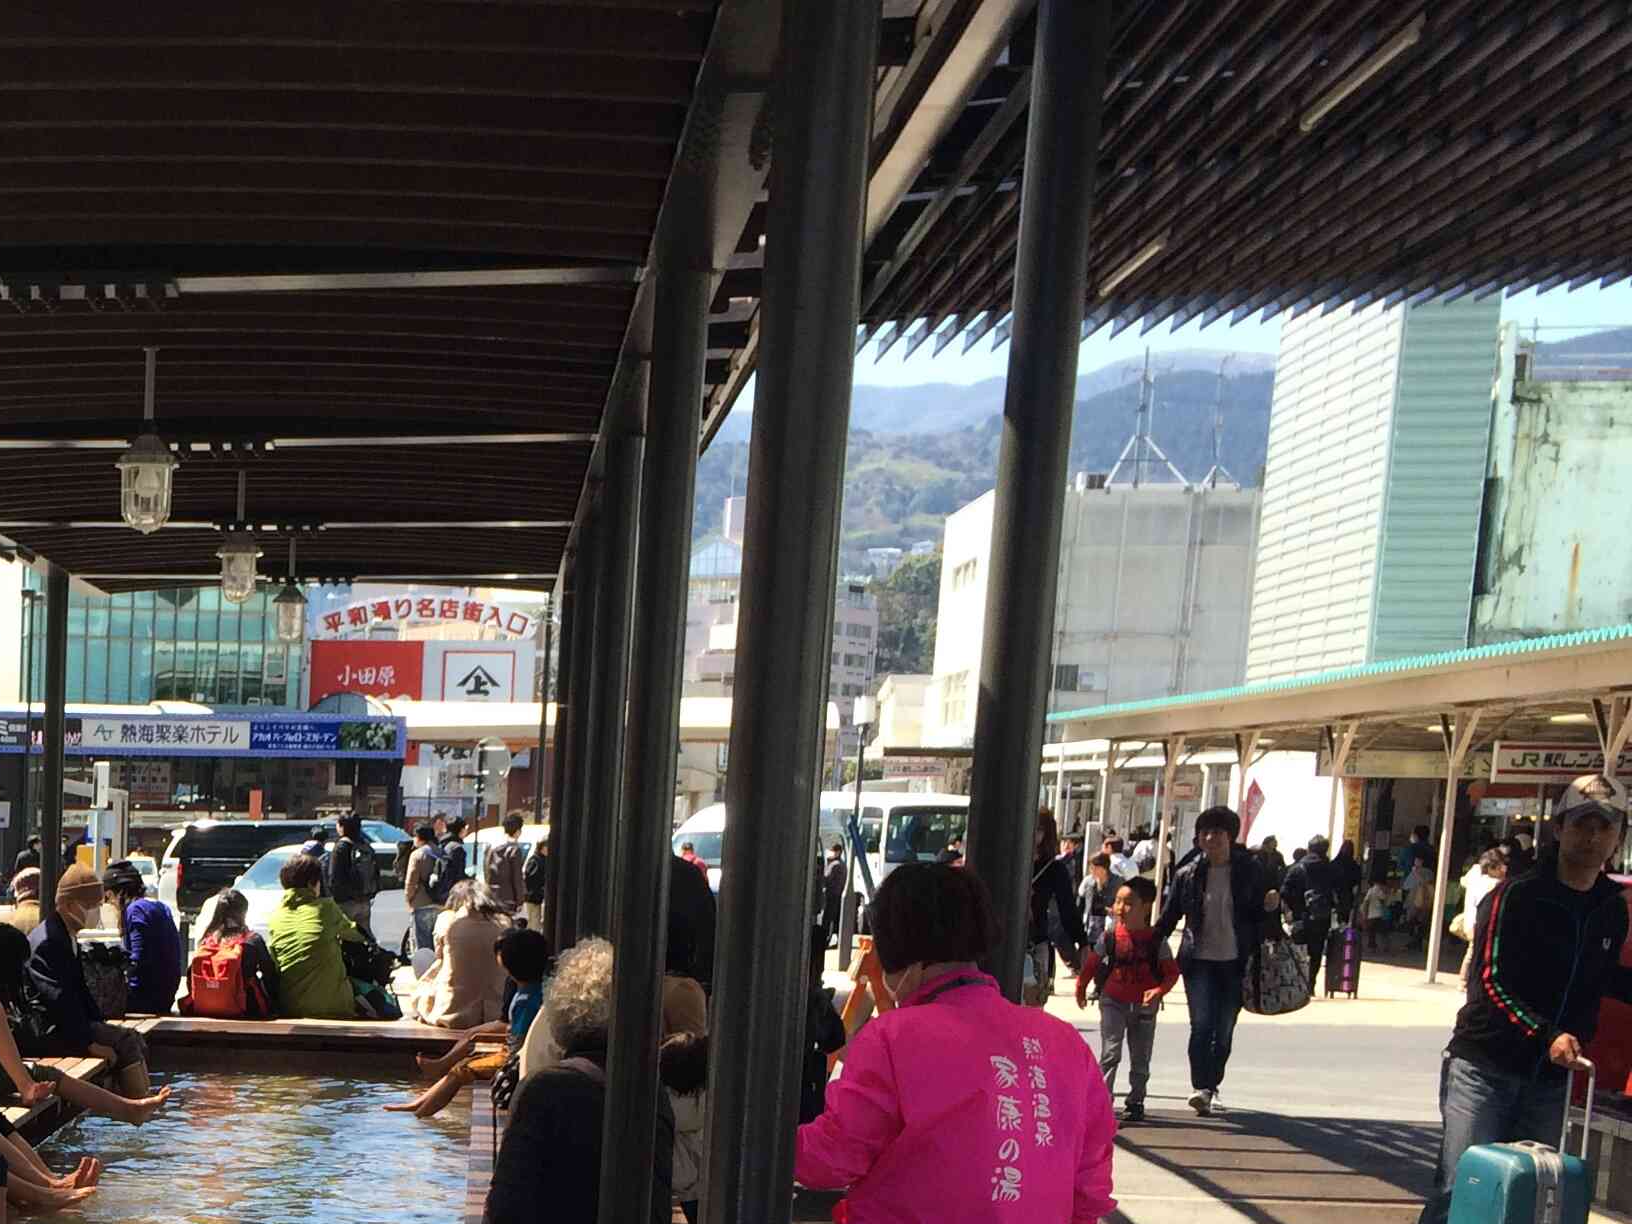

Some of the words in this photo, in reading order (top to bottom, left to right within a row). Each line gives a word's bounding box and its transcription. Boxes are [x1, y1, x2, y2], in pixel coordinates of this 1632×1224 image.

[323, 598, 529, 635] 平和通り名店街入口
[337, 664, 396, 687] 小田原
[121, 723, 240, 745] 熱海聚楽ホテル
[1511, 752, 1540, 767] JR
